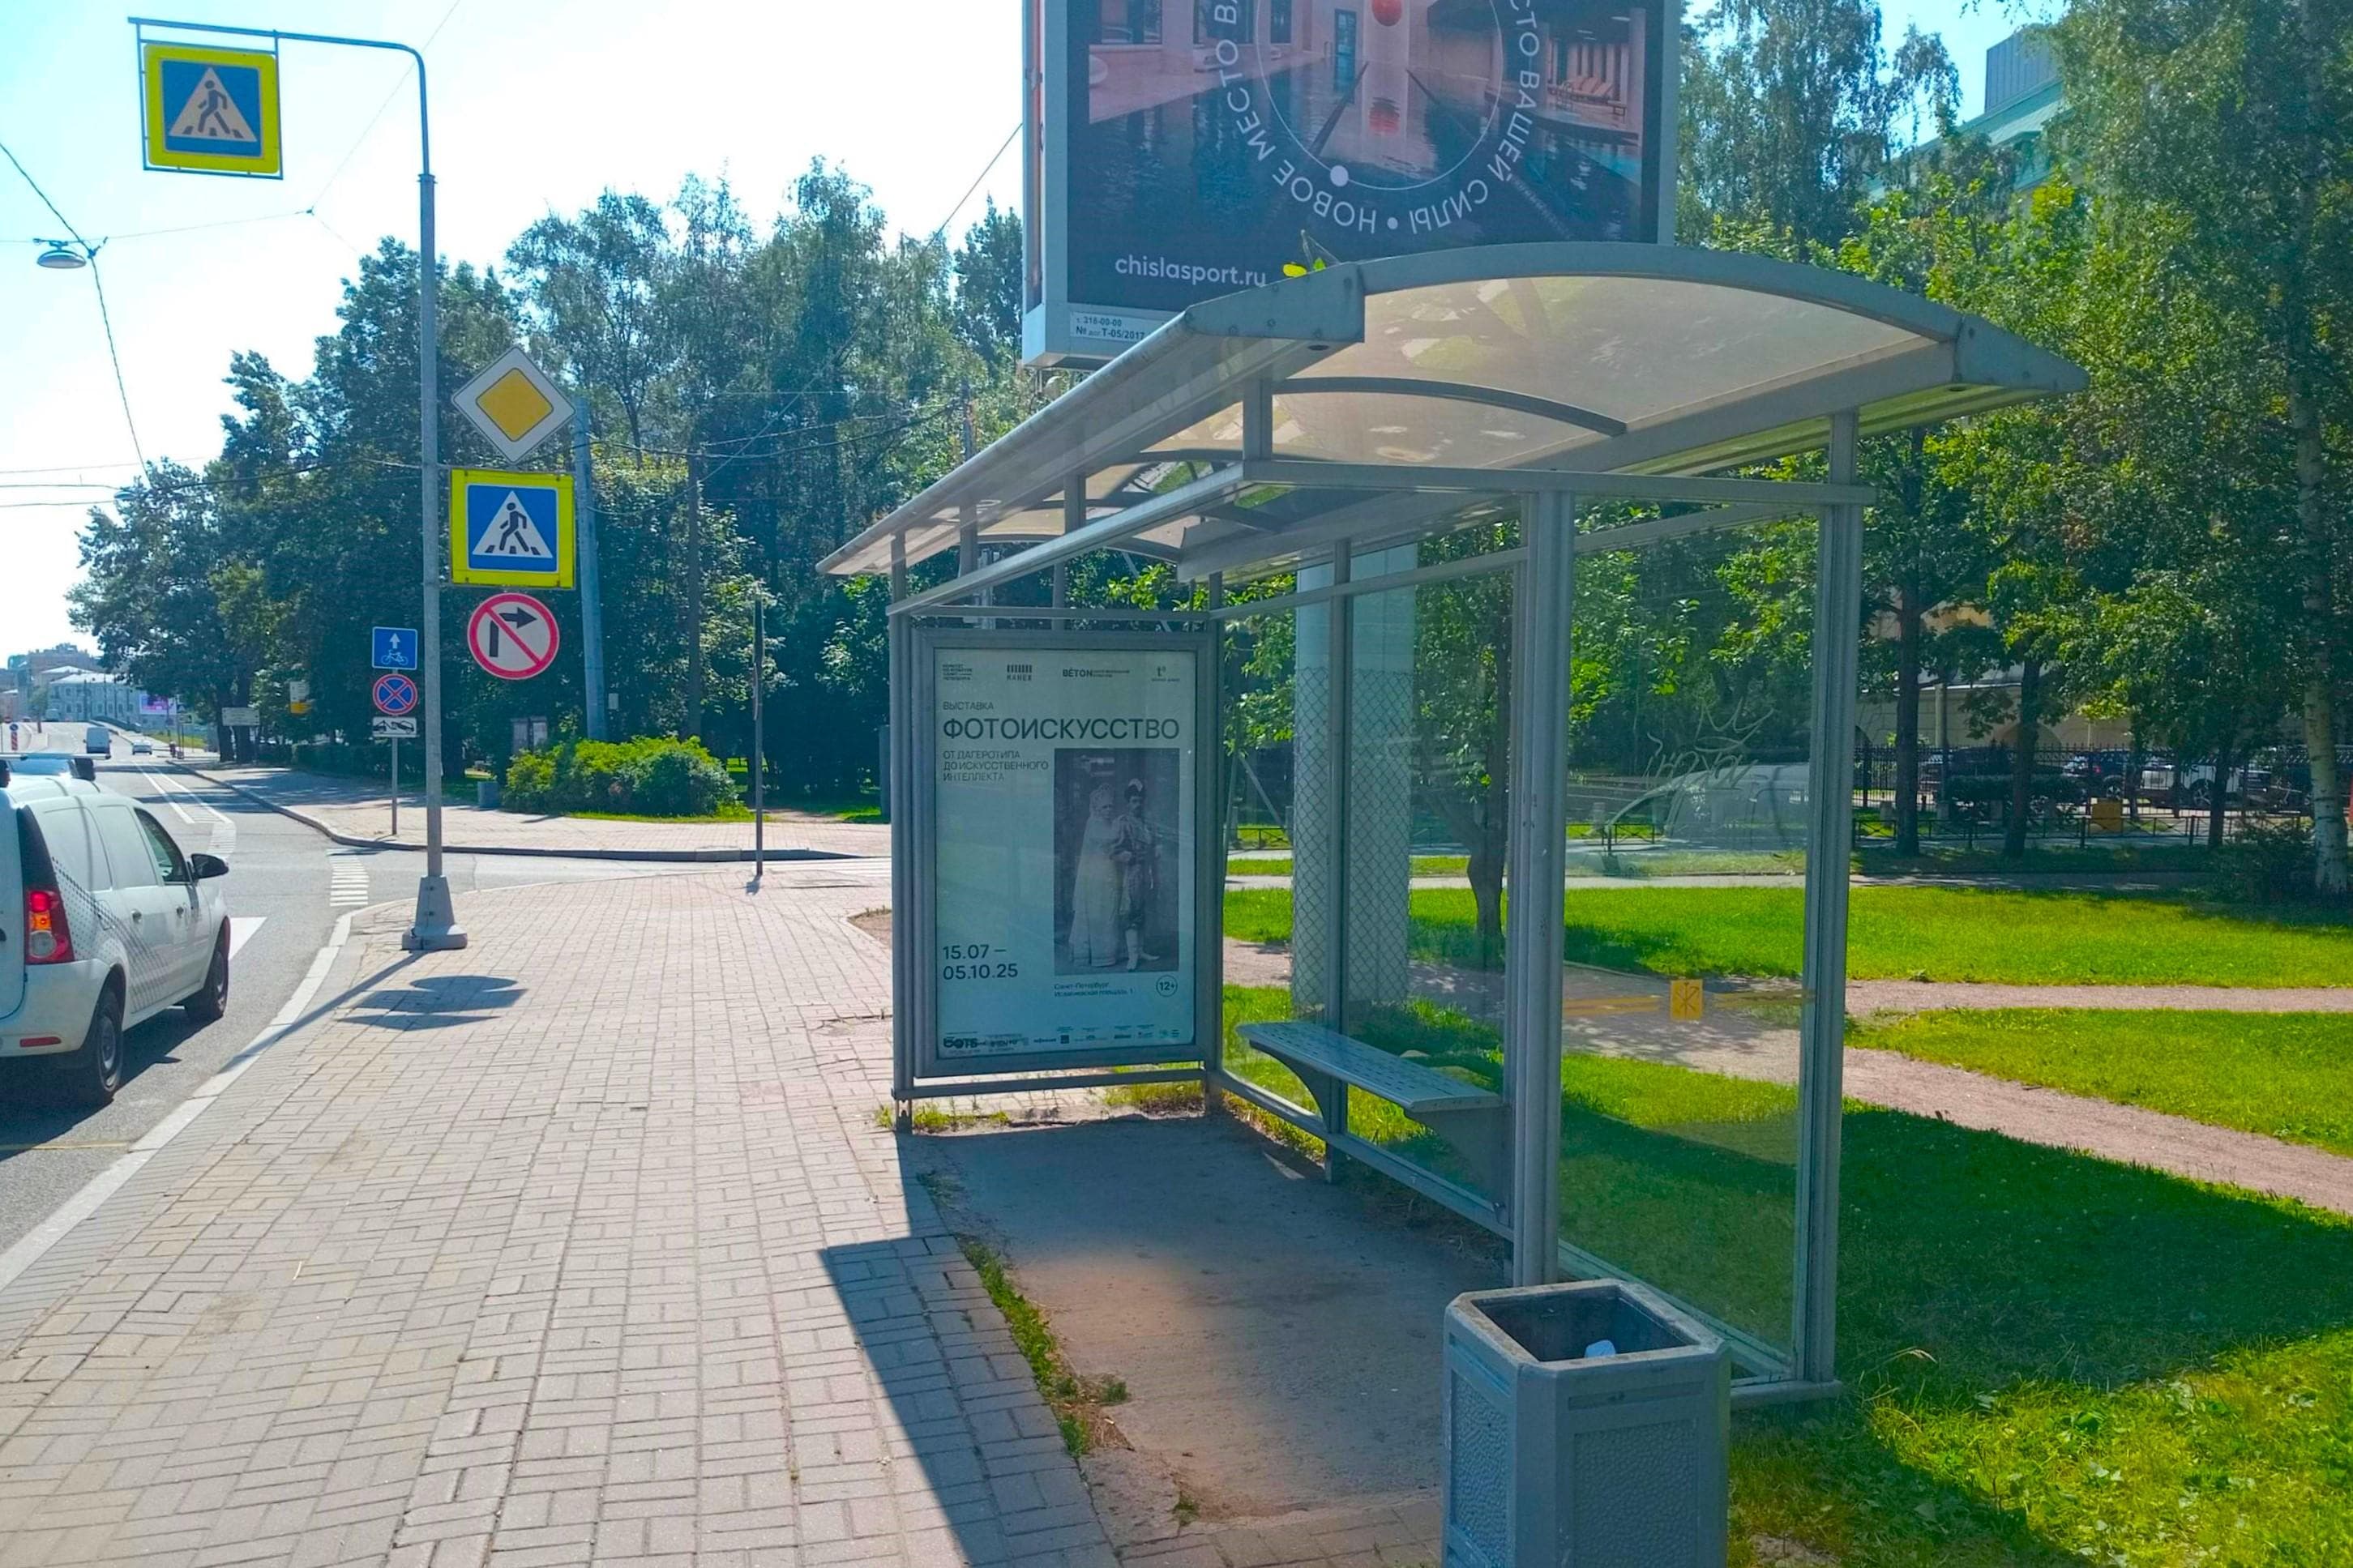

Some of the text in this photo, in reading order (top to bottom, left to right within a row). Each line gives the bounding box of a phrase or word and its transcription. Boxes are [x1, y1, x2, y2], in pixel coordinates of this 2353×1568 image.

[1216, 39, 1276, 160] МЕСТО
[1487, 70, 1540, 182] ВАШЕЙ
[1272, 159, 1376, 233] НОВОЕ
[1409, 179, 1488, 234] СИЛЫ
[1115, 254, 1266, 287] chislasport.ru
[943, 701, 994, 711] ВЫСТАВКА
[943, 718, 1179, 740] ФОТОИСКУССТВО
[943, 750, 1020, 760] ОТ ДАГЕРОТИПА
[943, 761, 1049, 771] ДО ИСКУССТВЕННОГО
[943, 772, 1005, 782] ИНТЕЛЛЕКТА
[943, 944, 990, 960] 15.07
[943, 963, 1019, 981] 05.10.25
[1159, 981, 1175, 991] 12+
